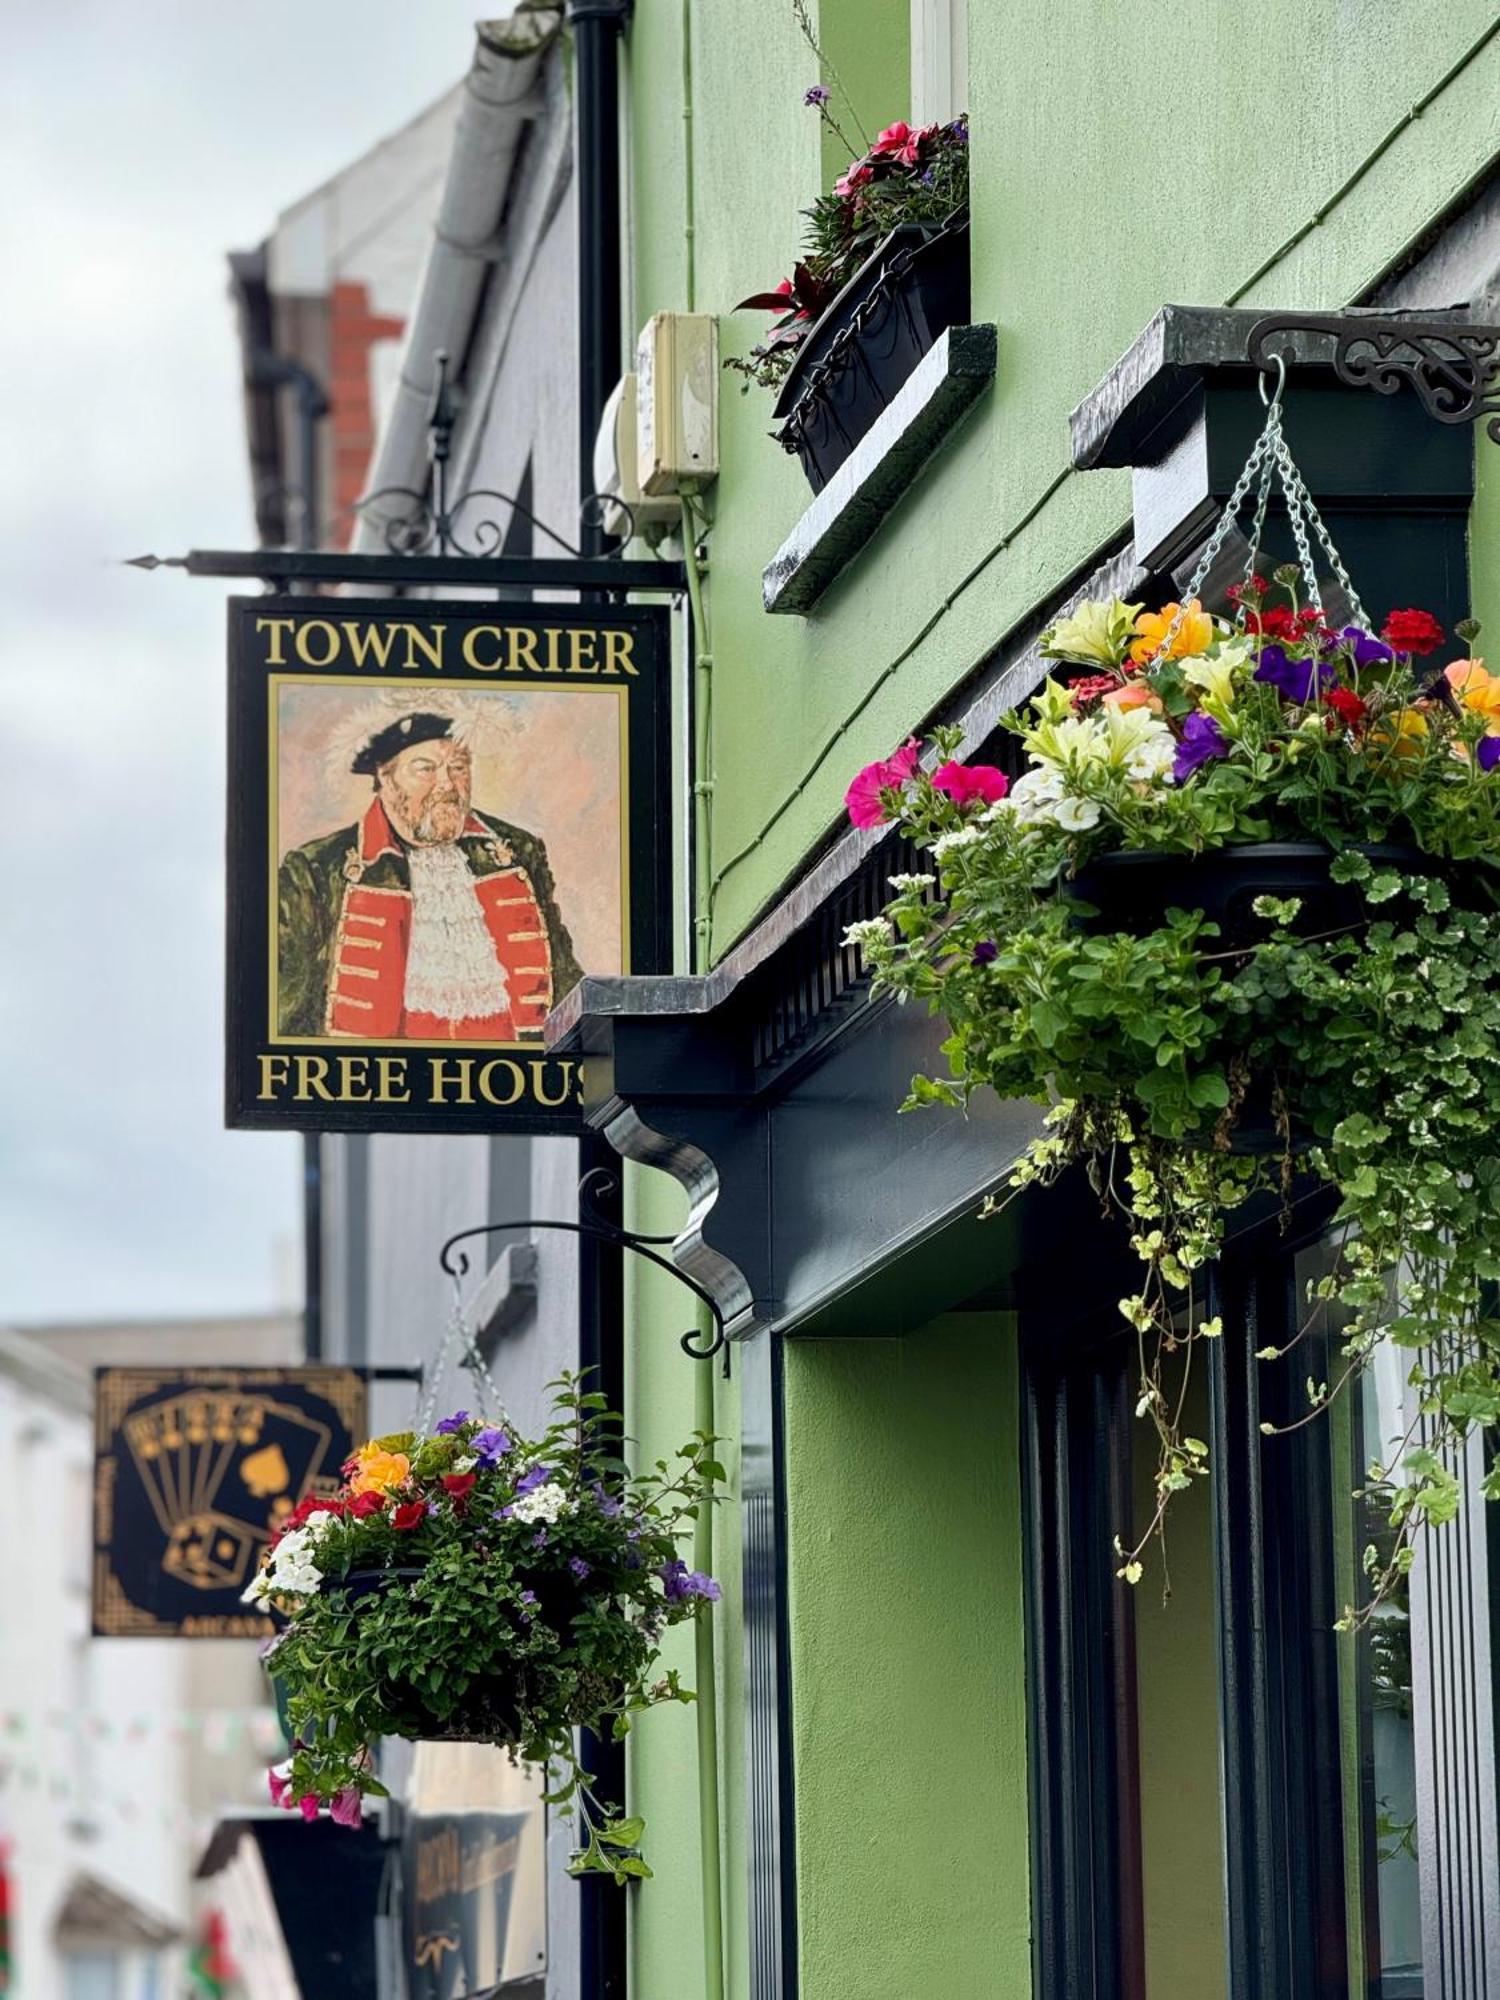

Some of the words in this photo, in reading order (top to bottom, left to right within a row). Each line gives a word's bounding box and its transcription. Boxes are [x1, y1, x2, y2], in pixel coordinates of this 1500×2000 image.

[256, 618, 446, 669] TOWN
[462, 625, 640, 675] CRIER
[256, 1054, 410, 1103] FREE
[427, 1058, 585, 1107] HOU
